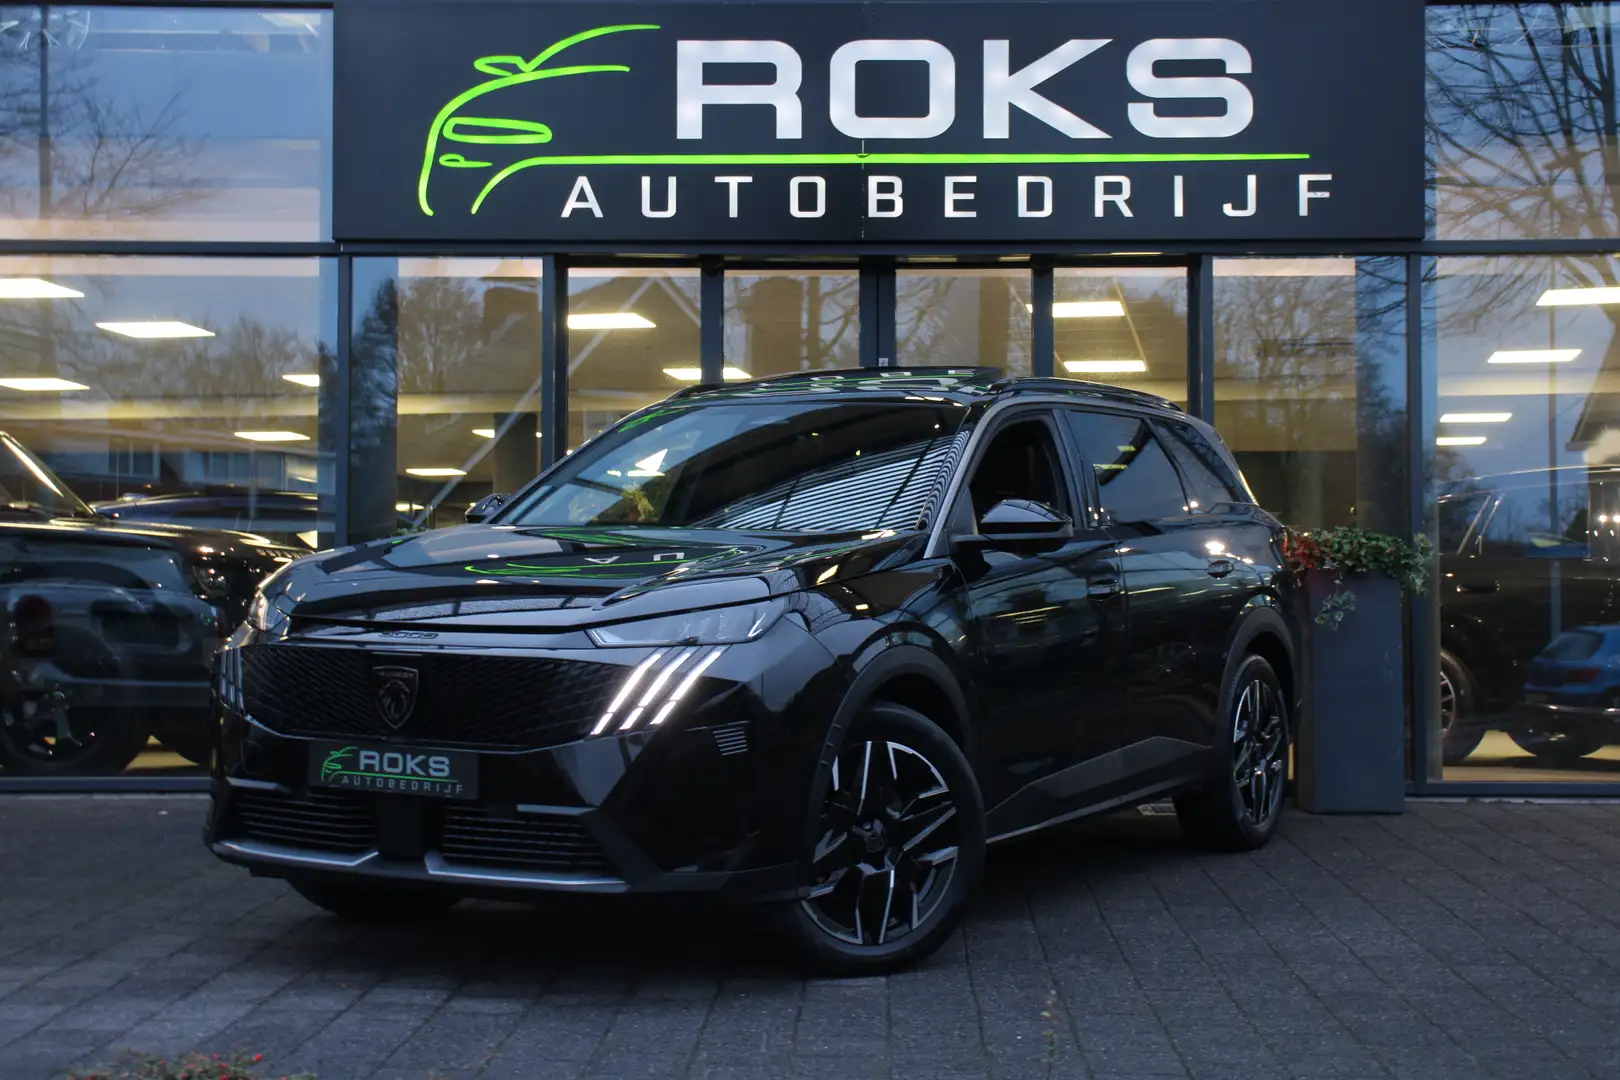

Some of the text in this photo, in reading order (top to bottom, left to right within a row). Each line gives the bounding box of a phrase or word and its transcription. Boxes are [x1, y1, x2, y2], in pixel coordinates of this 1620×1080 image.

[676, 38, 1253, 139] ROKS
[561, 173, 1333, 218] AUTOBEDRIJF
[359, 750, 450, 777] ROKS
[341, 775, 464, 794] AUTOBEDRIJF
